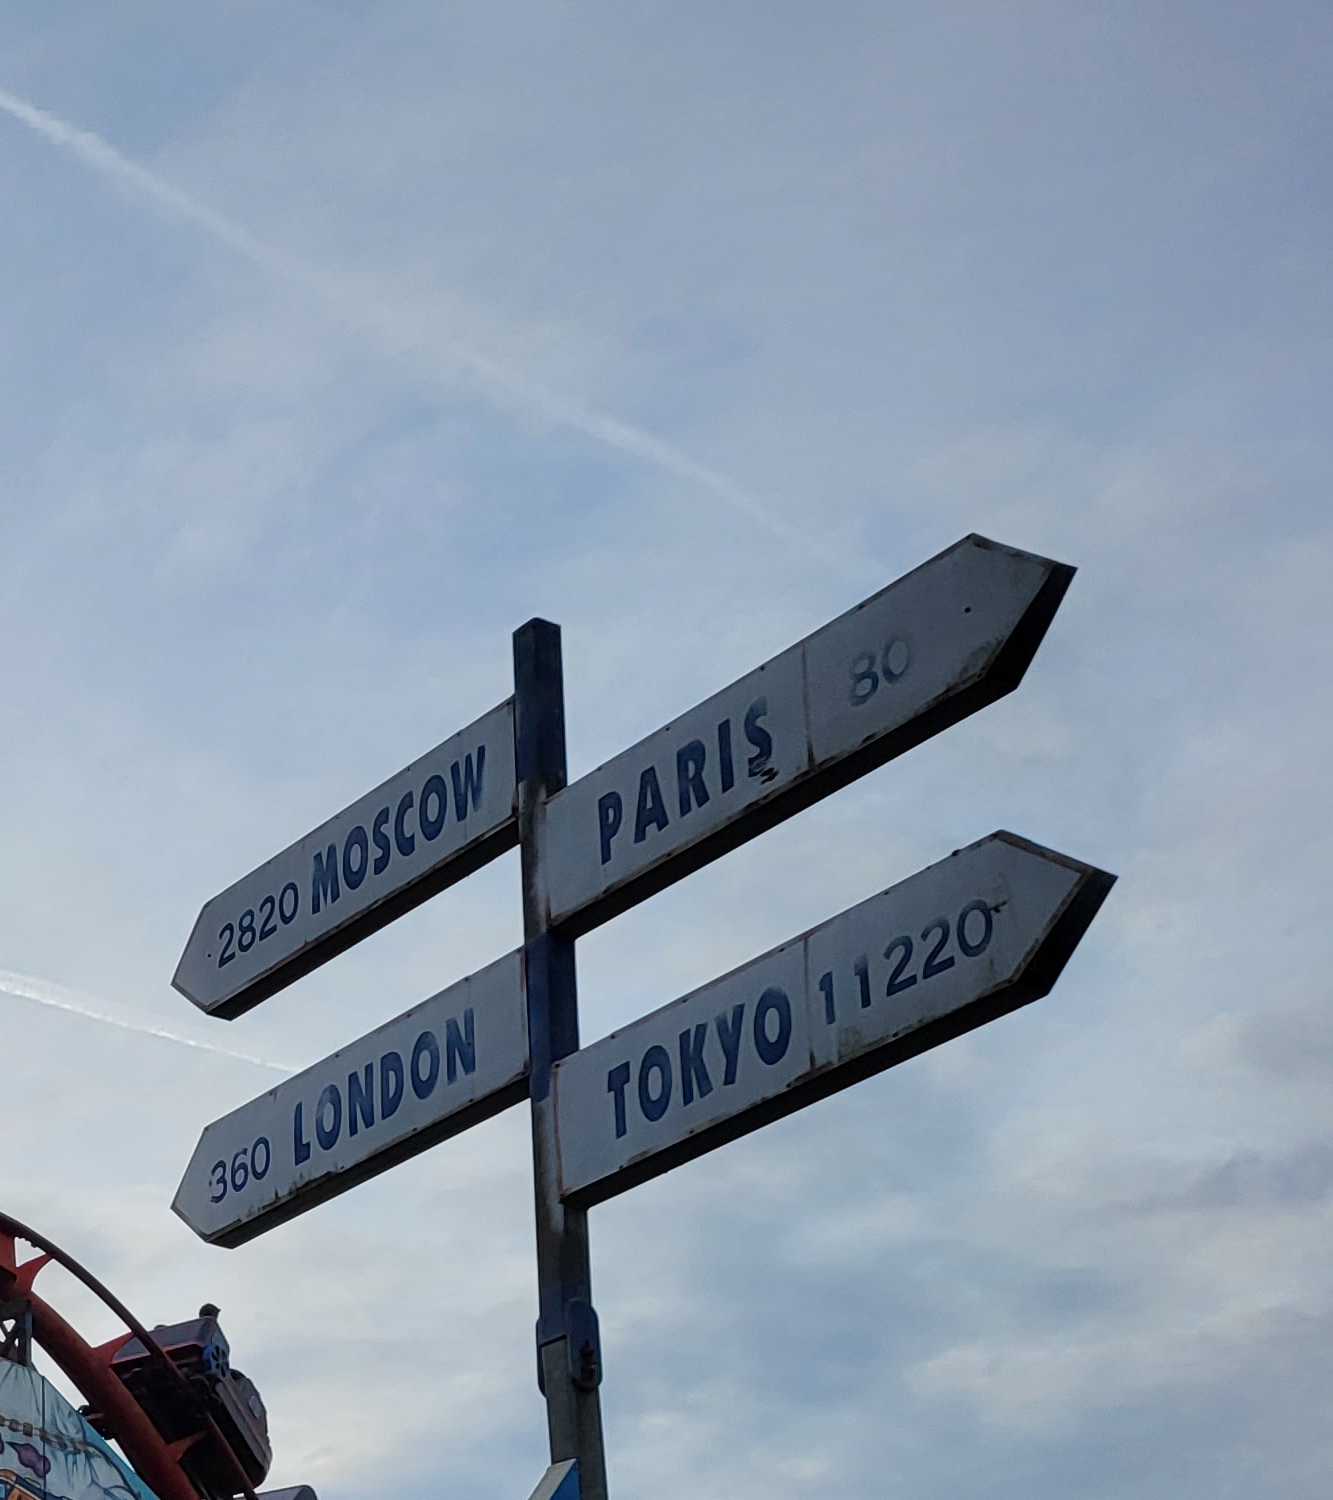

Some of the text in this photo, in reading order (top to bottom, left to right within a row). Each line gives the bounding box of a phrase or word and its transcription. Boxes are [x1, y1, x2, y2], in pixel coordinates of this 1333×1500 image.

[215, 745, 486, 970] 2820 MOSCOW
[596, 631, 913, 864] PARIS 80
[208, 1007, 476, 1205] 360 LONDON
[606, 899, 996, 1139] TOKYO 11220
